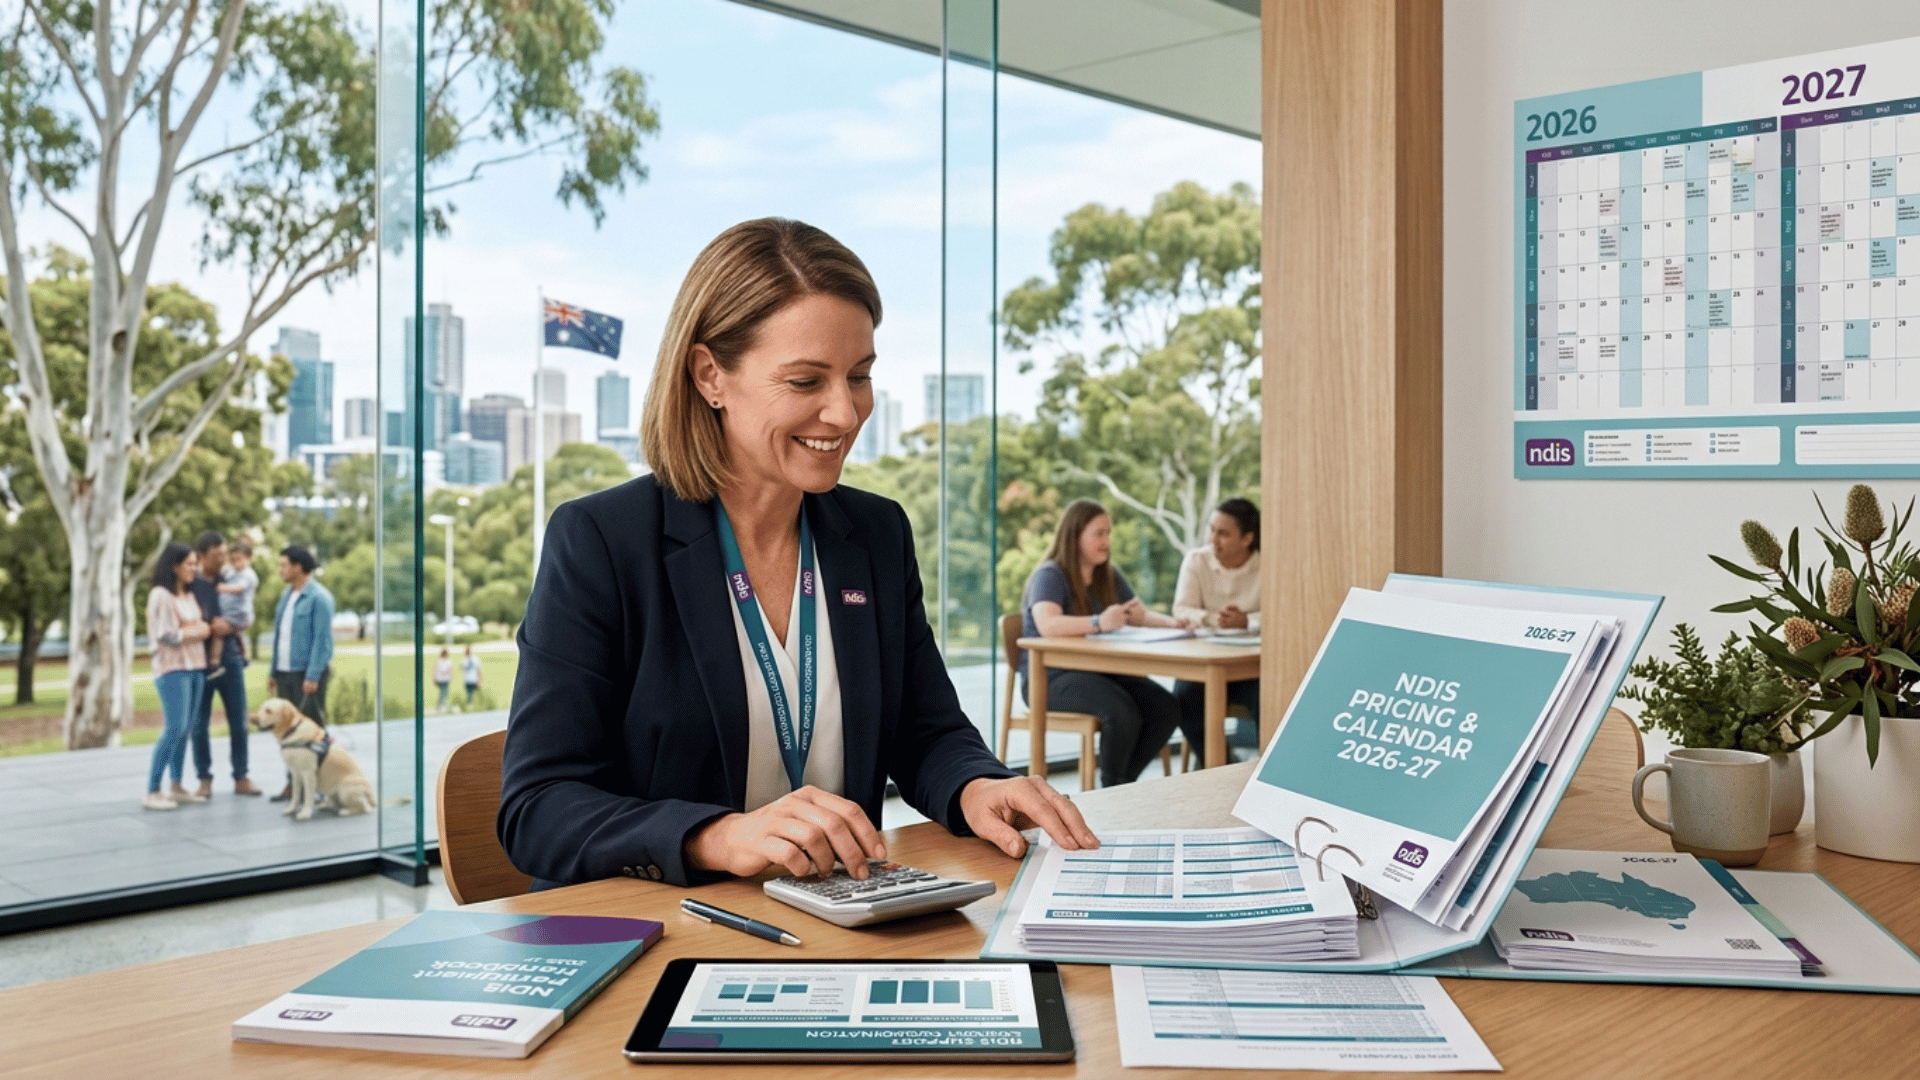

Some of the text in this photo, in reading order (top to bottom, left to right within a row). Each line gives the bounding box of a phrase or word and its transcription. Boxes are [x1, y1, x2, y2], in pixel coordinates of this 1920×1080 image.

[1781, 63, 1867, 106] 2027
[1526, 105, 1597, 142] 2026
[1530, 442, 1571, 462] ndis
[1395, 672, 1461, 701] NDIS
[1348, 688, 1479, 734] PRICING &
[1332, 712, 1473, 761] CALENDAR
[1337, 740, 1441, 779] 2026-27
